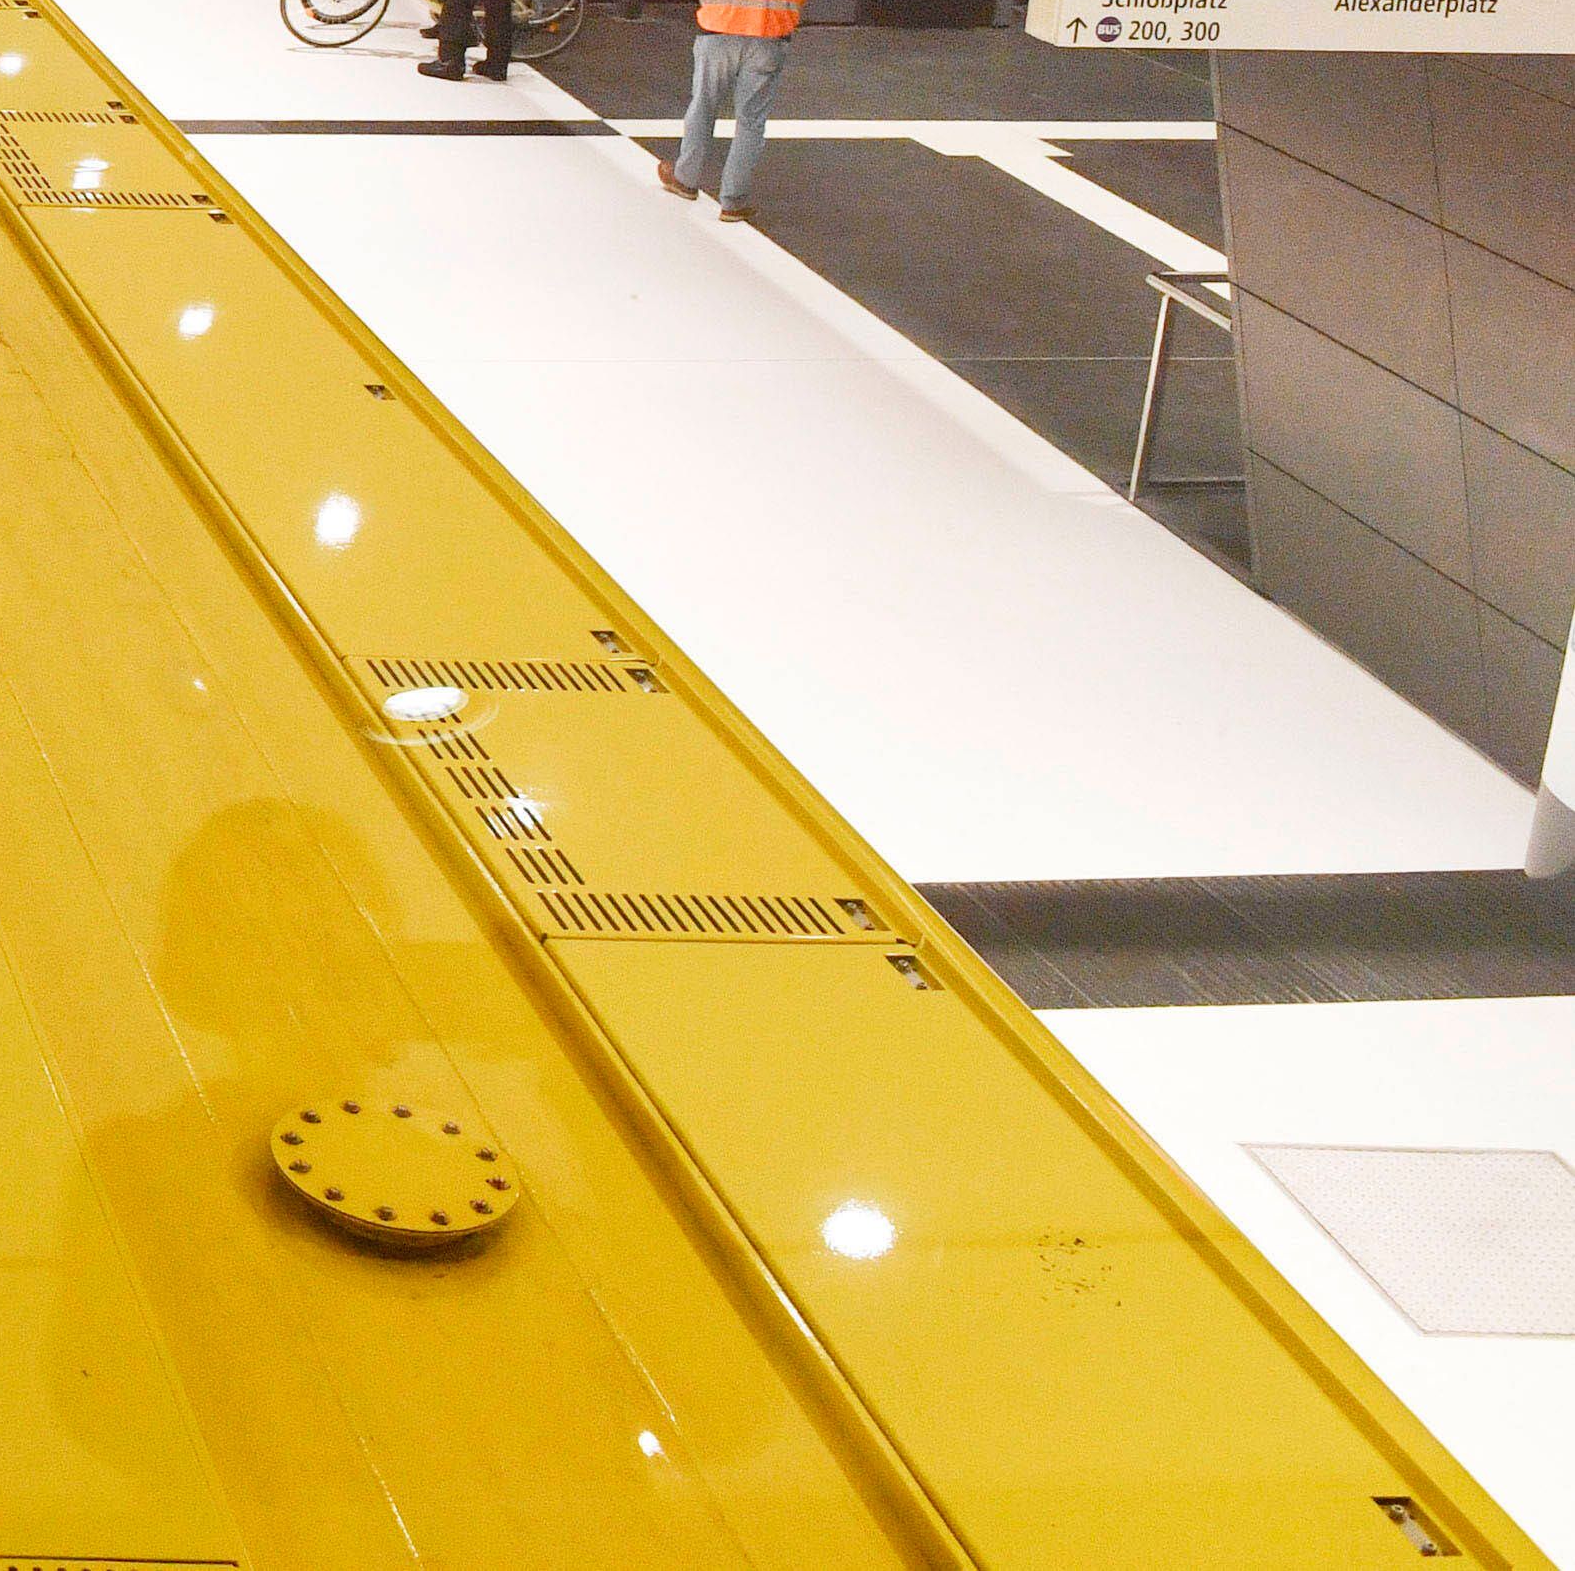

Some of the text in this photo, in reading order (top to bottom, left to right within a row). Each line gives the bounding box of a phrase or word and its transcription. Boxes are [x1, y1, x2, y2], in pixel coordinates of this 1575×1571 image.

[1097, 20, 1221, 43] BUS 200, 300
